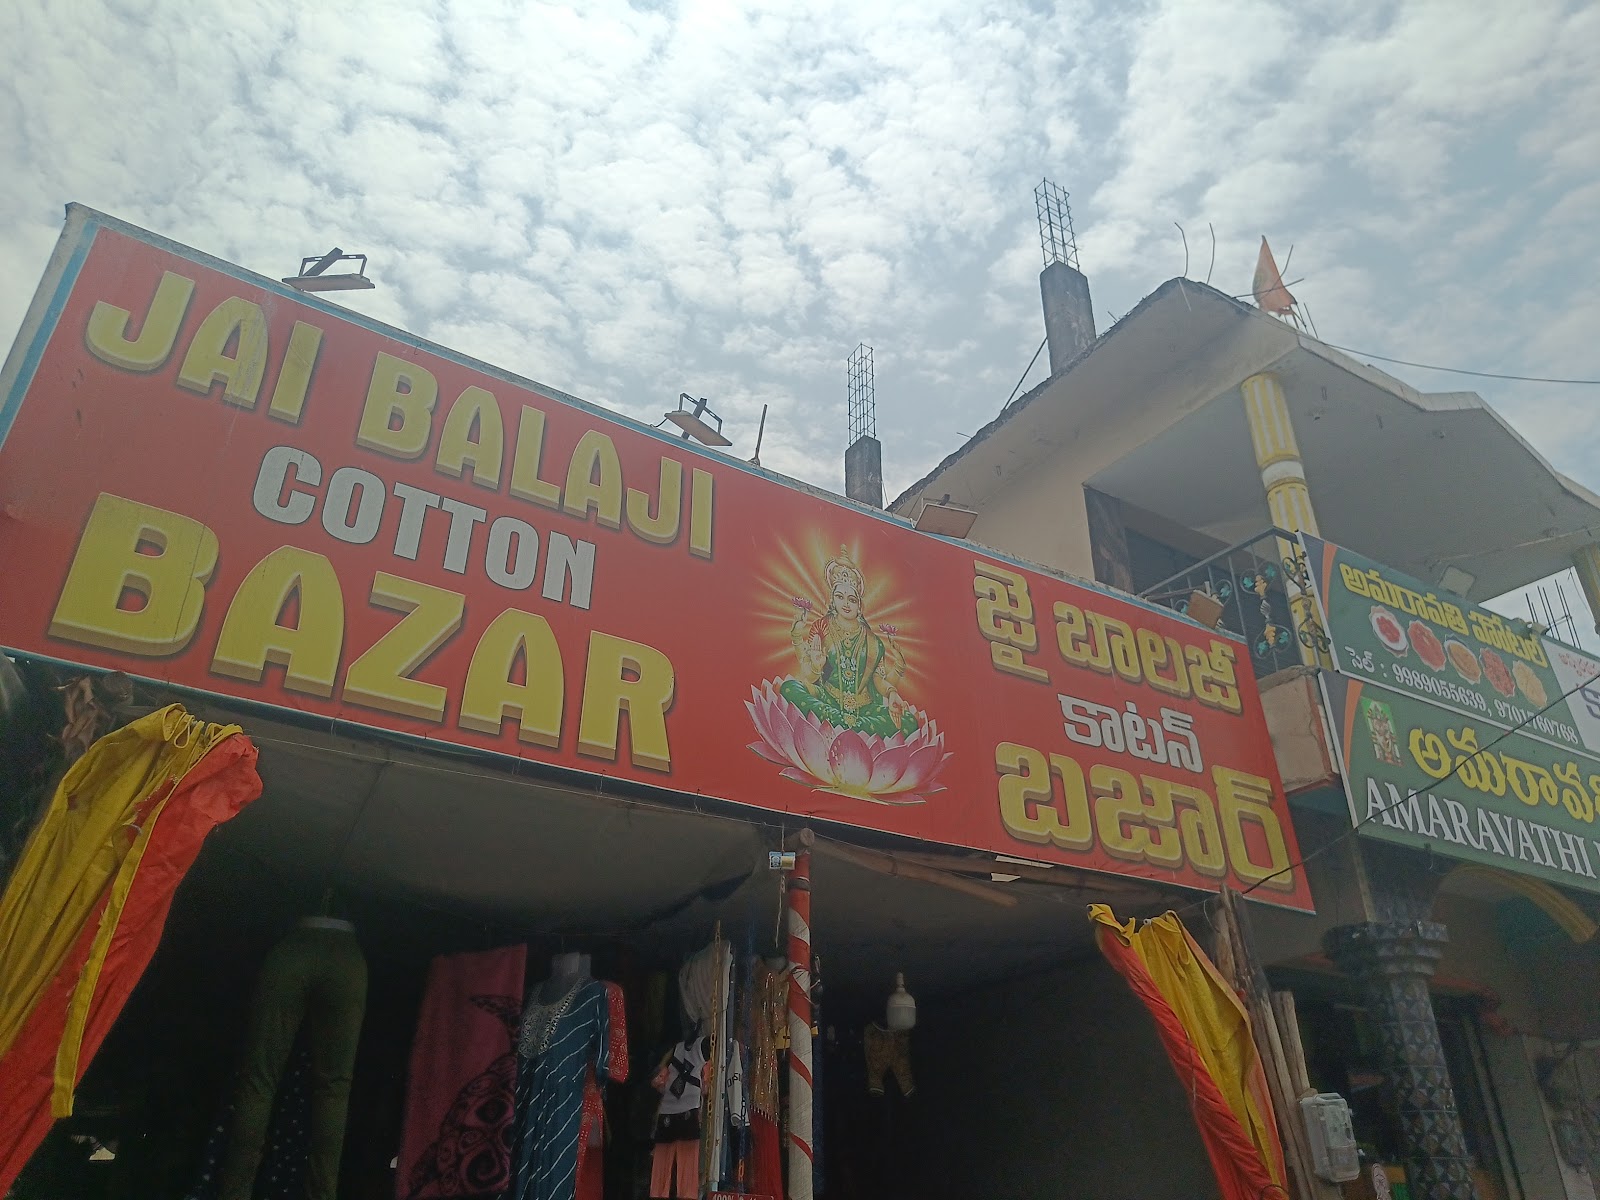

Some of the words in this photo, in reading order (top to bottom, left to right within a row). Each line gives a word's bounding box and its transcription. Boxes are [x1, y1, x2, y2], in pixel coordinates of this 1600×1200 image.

[86, 271, 324, 424] JAI
[357, 351, 713, 559] BALAJI
[252, 446, 597, 609] COTTON
[48, 491, 675, 772] BAZAR
[973, 560, 1050, 684] జై
[1057, 693, 1204, 774] కాటన్
[995, 742, 1294, 890] బజార్
[1365, 777, 1597, 879] AMARAVATHI
